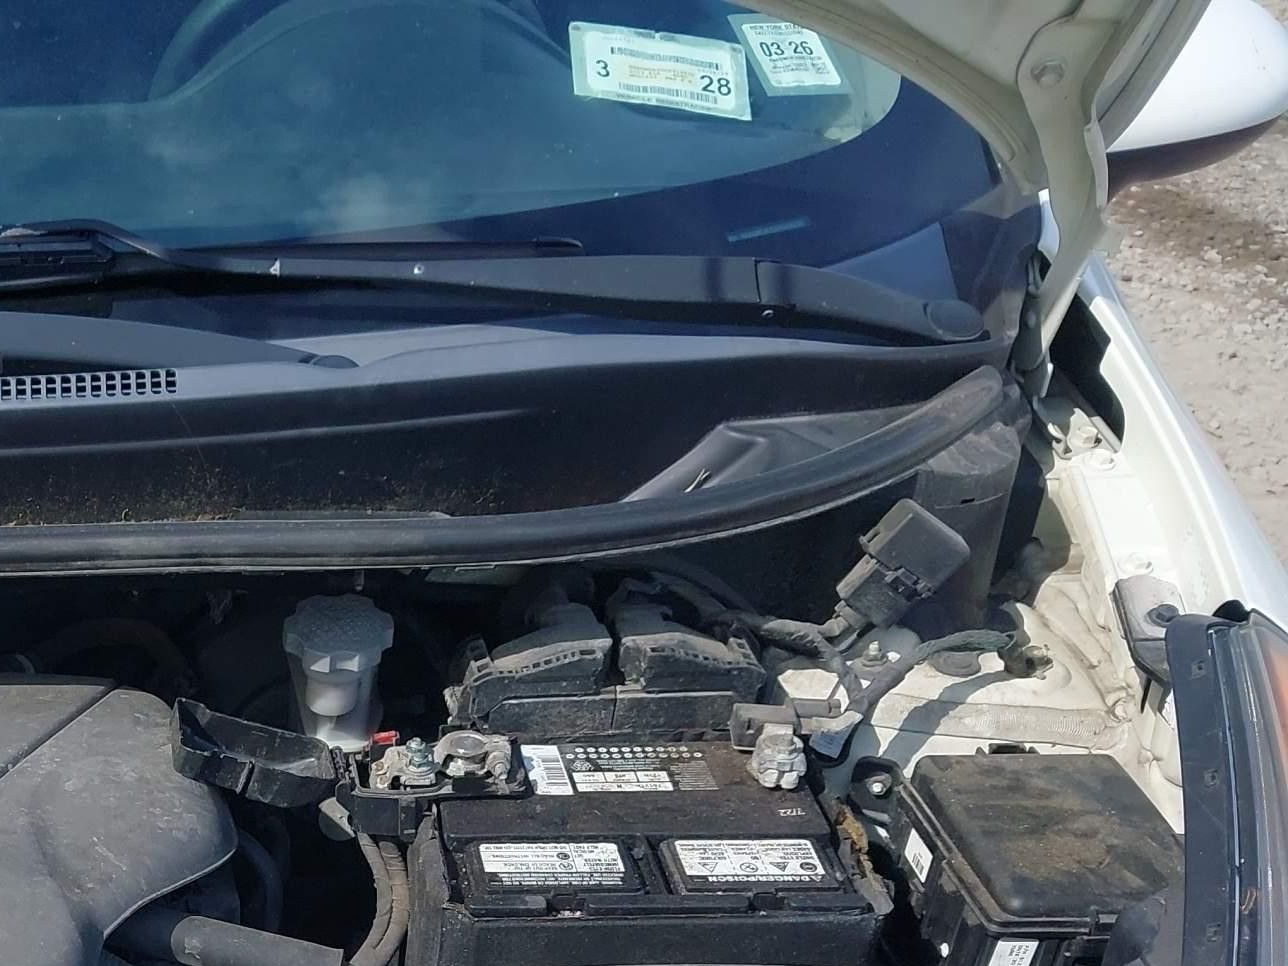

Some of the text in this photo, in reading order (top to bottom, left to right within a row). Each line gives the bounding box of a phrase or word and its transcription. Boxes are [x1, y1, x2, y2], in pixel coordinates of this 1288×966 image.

[759, 41, 813, 57] 03 26
[595, 59, 610, 77] 3
[699, 74, 731, 96] 28
